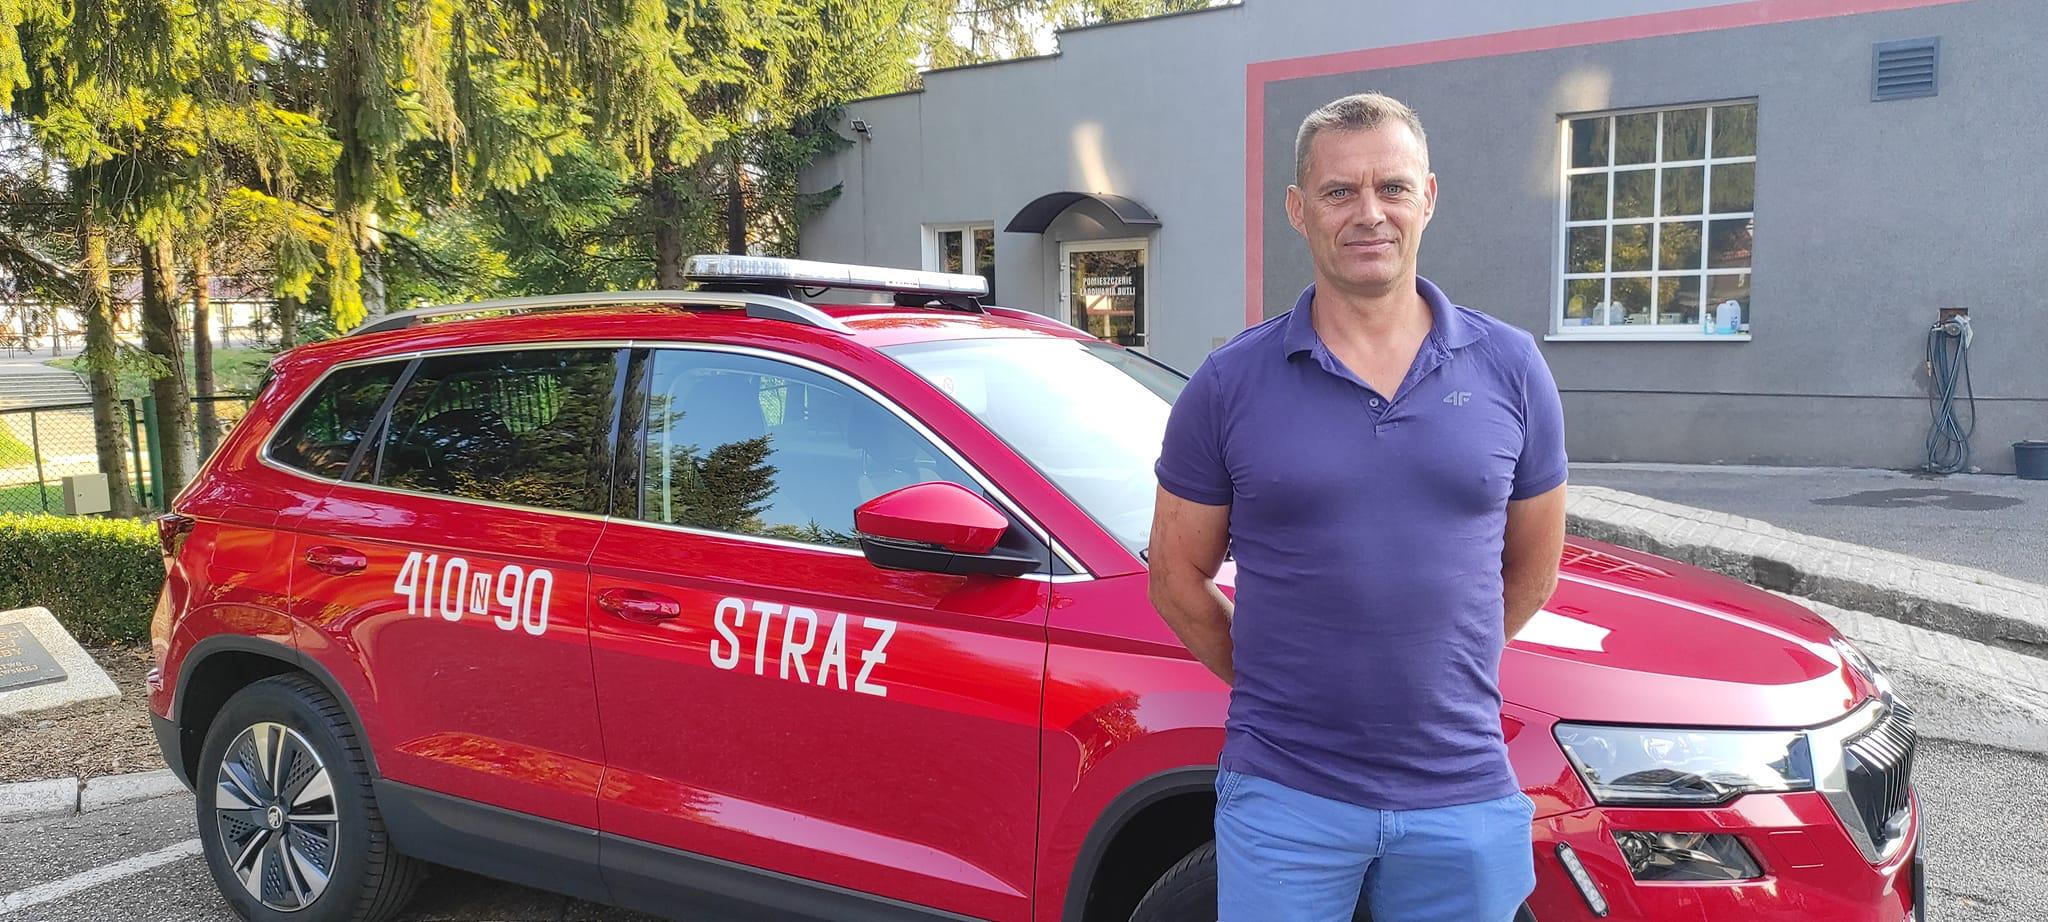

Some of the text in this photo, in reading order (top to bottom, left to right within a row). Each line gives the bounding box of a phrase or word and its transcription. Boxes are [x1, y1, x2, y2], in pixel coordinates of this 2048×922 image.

[1083, 276, 1132, 286] POMIESZCZENIE
[1117, 287, 1136, 296] BUTLI
[1443, 391, 1472, 406] 4F
